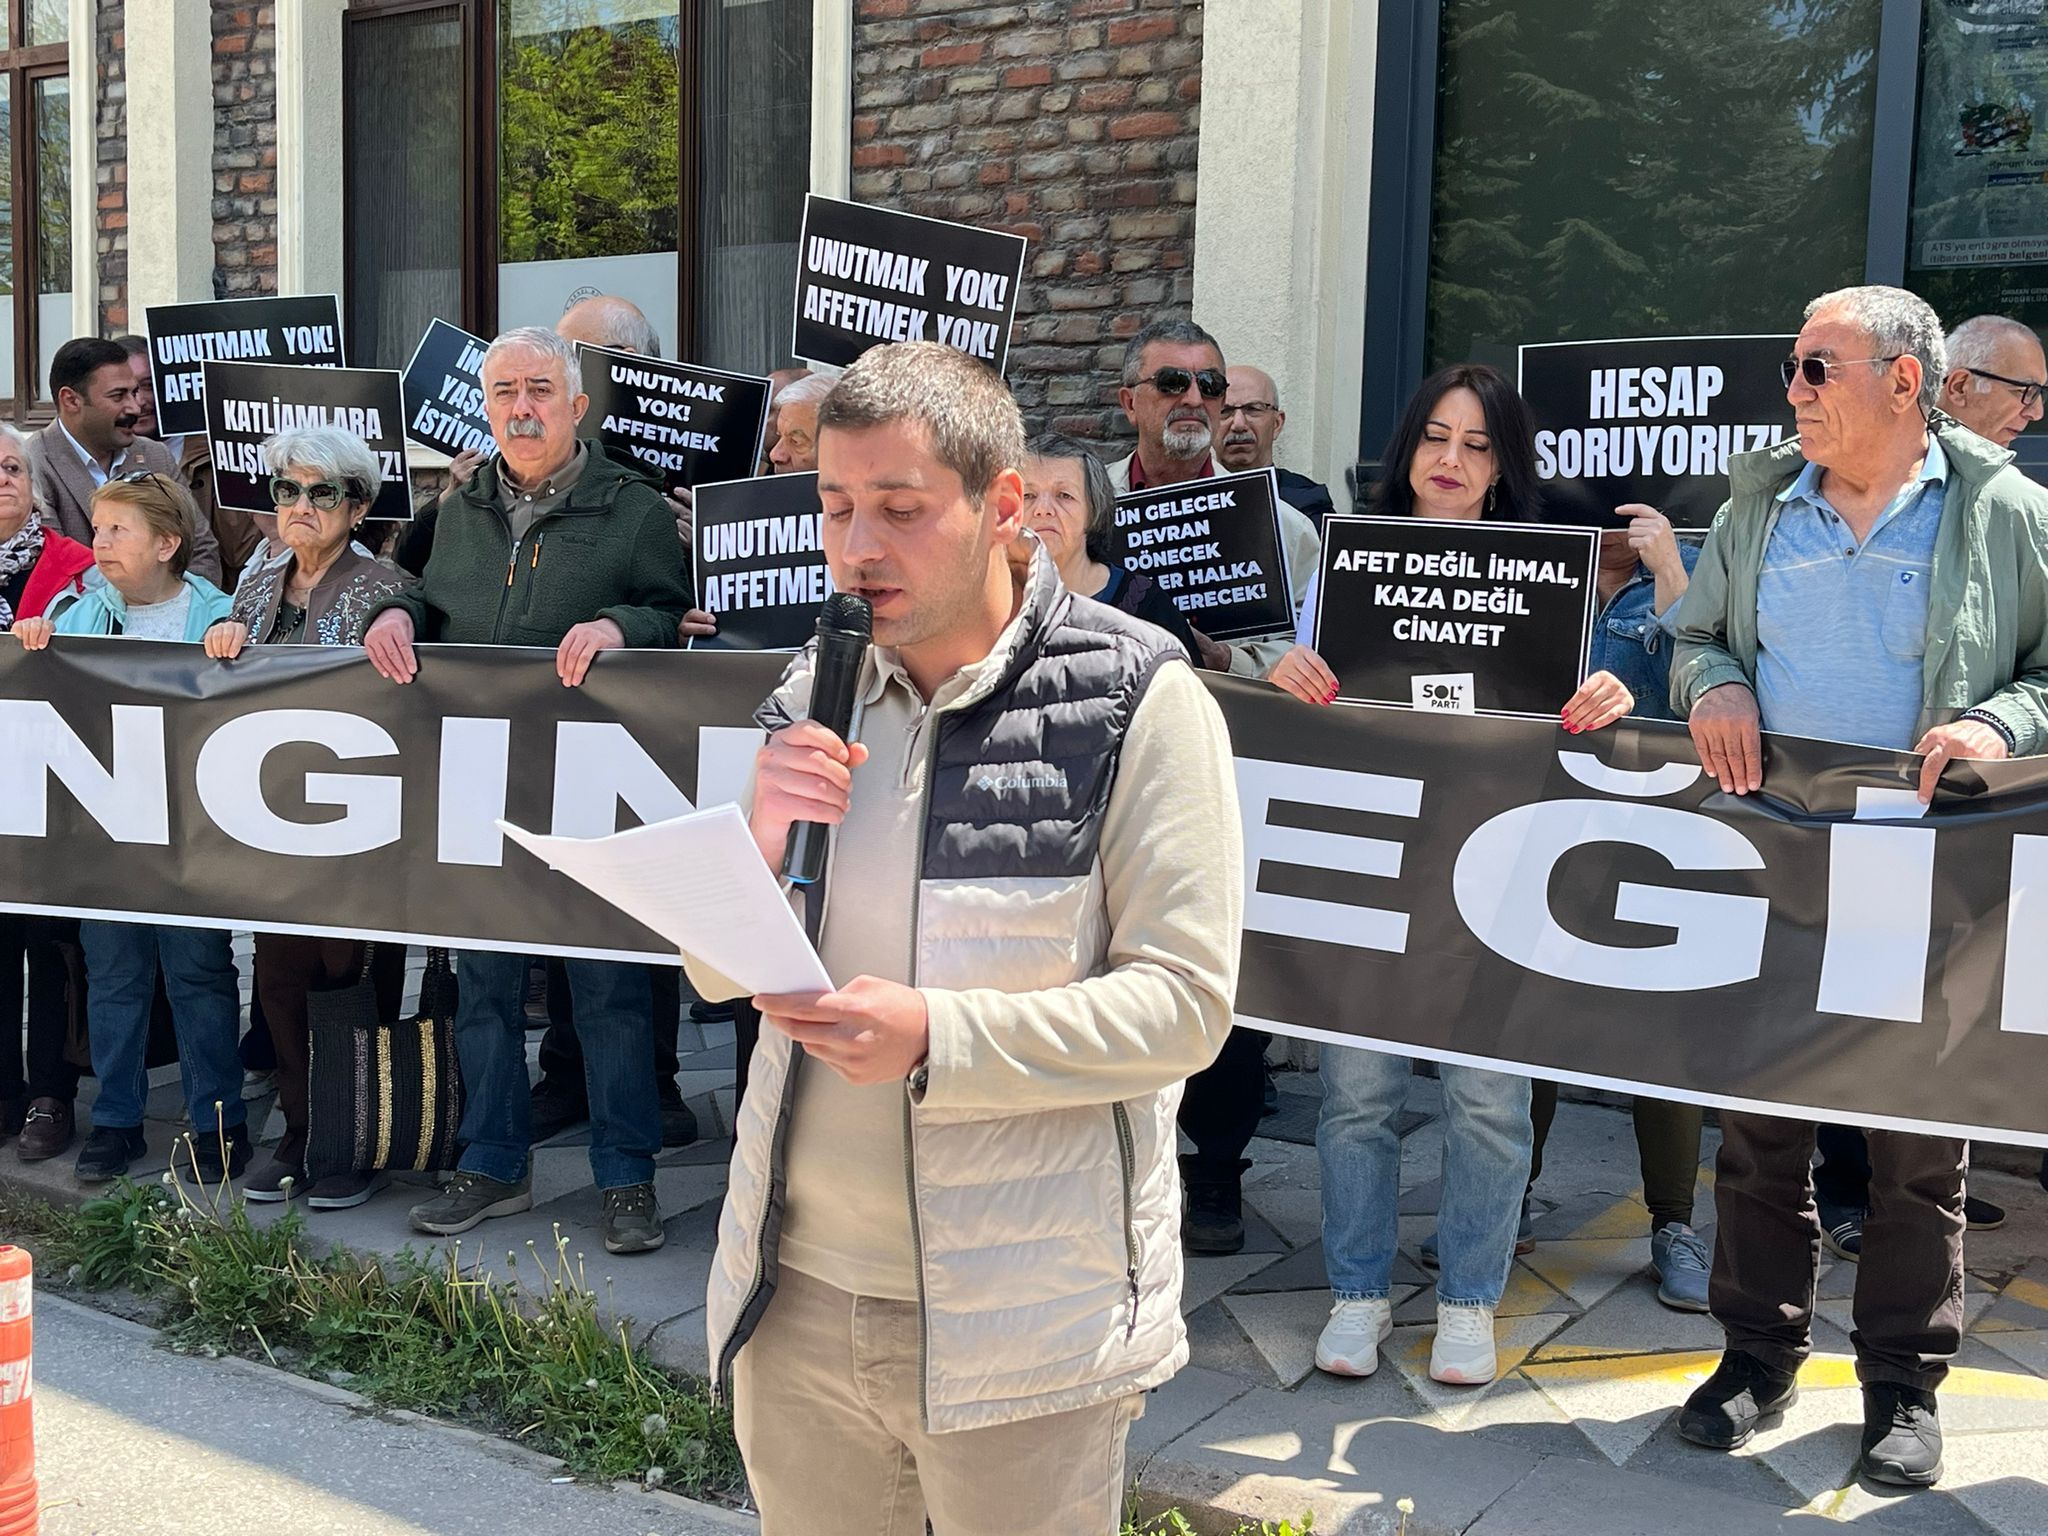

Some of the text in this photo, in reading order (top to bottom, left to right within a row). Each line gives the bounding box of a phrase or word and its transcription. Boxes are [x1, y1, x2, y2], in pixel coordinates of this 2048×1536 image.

[807, 235, 1009, 312] UNUTMAK YOK!
[803, 284, 999, 359] AFFETMEK YOK!
[157, 325, 335, 366] UNUTMAK YOK!
[455, 339, 486, 378] İN
[164, 372, 203, 403] AFF
[610, 365, 726, 403] UNUTMAK
[1589, 365, 1724, 420] HESAP
[637, 395, 691, 422] YOK!
[412, 399, 500, 460] İSTİYOR
[601, 414, 720, 453] AFFETMEK
[630, 444, 684, 471] YOK!
[1114, 490, 1237, 527] ÜN GELECEK
[1127, 519, 1211, 549] DEVRAN
[1124, 542, 1222, 572] DÖNECEK
[1158, 560, 1264, 590] ER HALKA
[1333, 549, 1579, 589] AFET DEĞİL İHMAL,
[1373, 584, 1530, 615] KAZA DEĞİL
[1393, 615, 1505, 647] CİNAYET
[1422, 684, 1460, 700] SOL
[994, 774, 1068, 790] Columbia
[1234, 750, 2048, 1034] EĞİ
